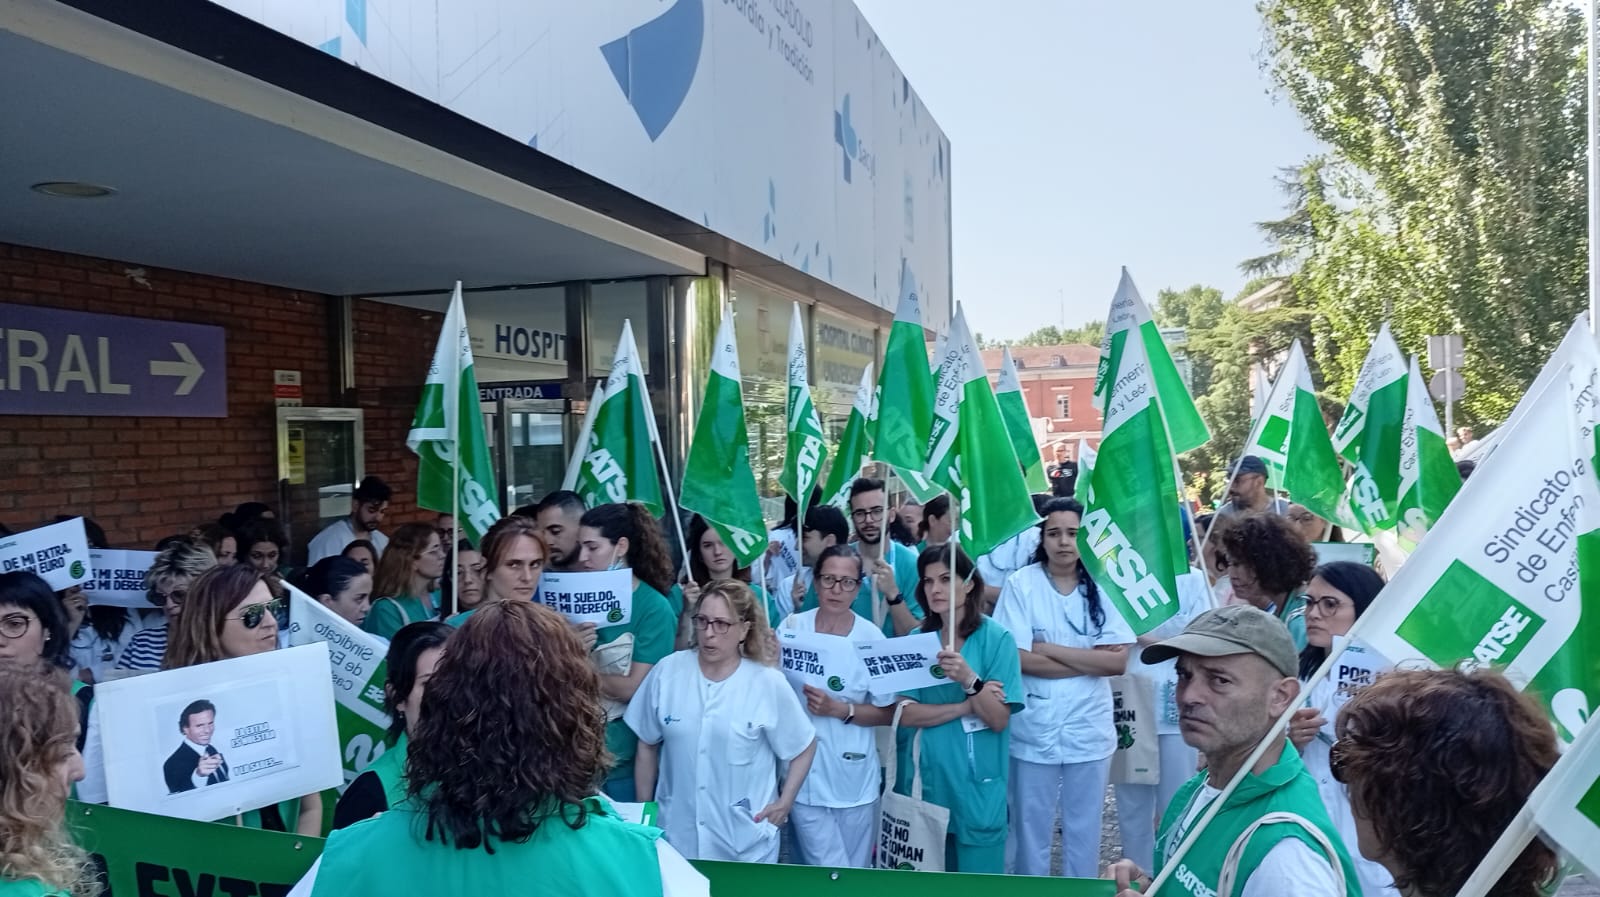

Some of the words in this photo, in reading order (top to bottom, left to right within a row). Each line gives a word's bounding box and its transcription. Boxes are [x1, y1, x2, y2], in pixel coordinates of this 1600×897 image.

[776, 24, 814, 86] Tradición
[0, 327, 131, 395] RAL
[480, 386, 544, 400] ENTRADA
[1484, 470, 1571, 563] Sindicato
[1080, 483, 1172, 621] ATSE
[3, 557, 20, 571] DE
[21, 553, 35, 566] MI
[39, 556, 65, 574] EURO
[1517, 553, 1547, 584] de
[98, 568, 111, 579] MI
[83, 580, 96, 590] ES
[98, 580, 111, 590] MI
[113, 580, 149, 590] DEREC
[544, 591, 557, 601] ES
[559, 592, 571, 602] MI
[560, 603, 572, 613] MI
[574, 600, 620, 614] DERECHO
[782, 647, 792, 658] MI
[793, 649, 819, 663] EXTRA
[863, 656, 878, 666] DE
[878, 655, 892, 664] MI
[783, 658, 794, 670] NO
[795, 660, 804, 671] SE
[868, 666, 880, 676] NI
[880, 663, 896, 674] UN
[894, 826, 909, 843] NO
